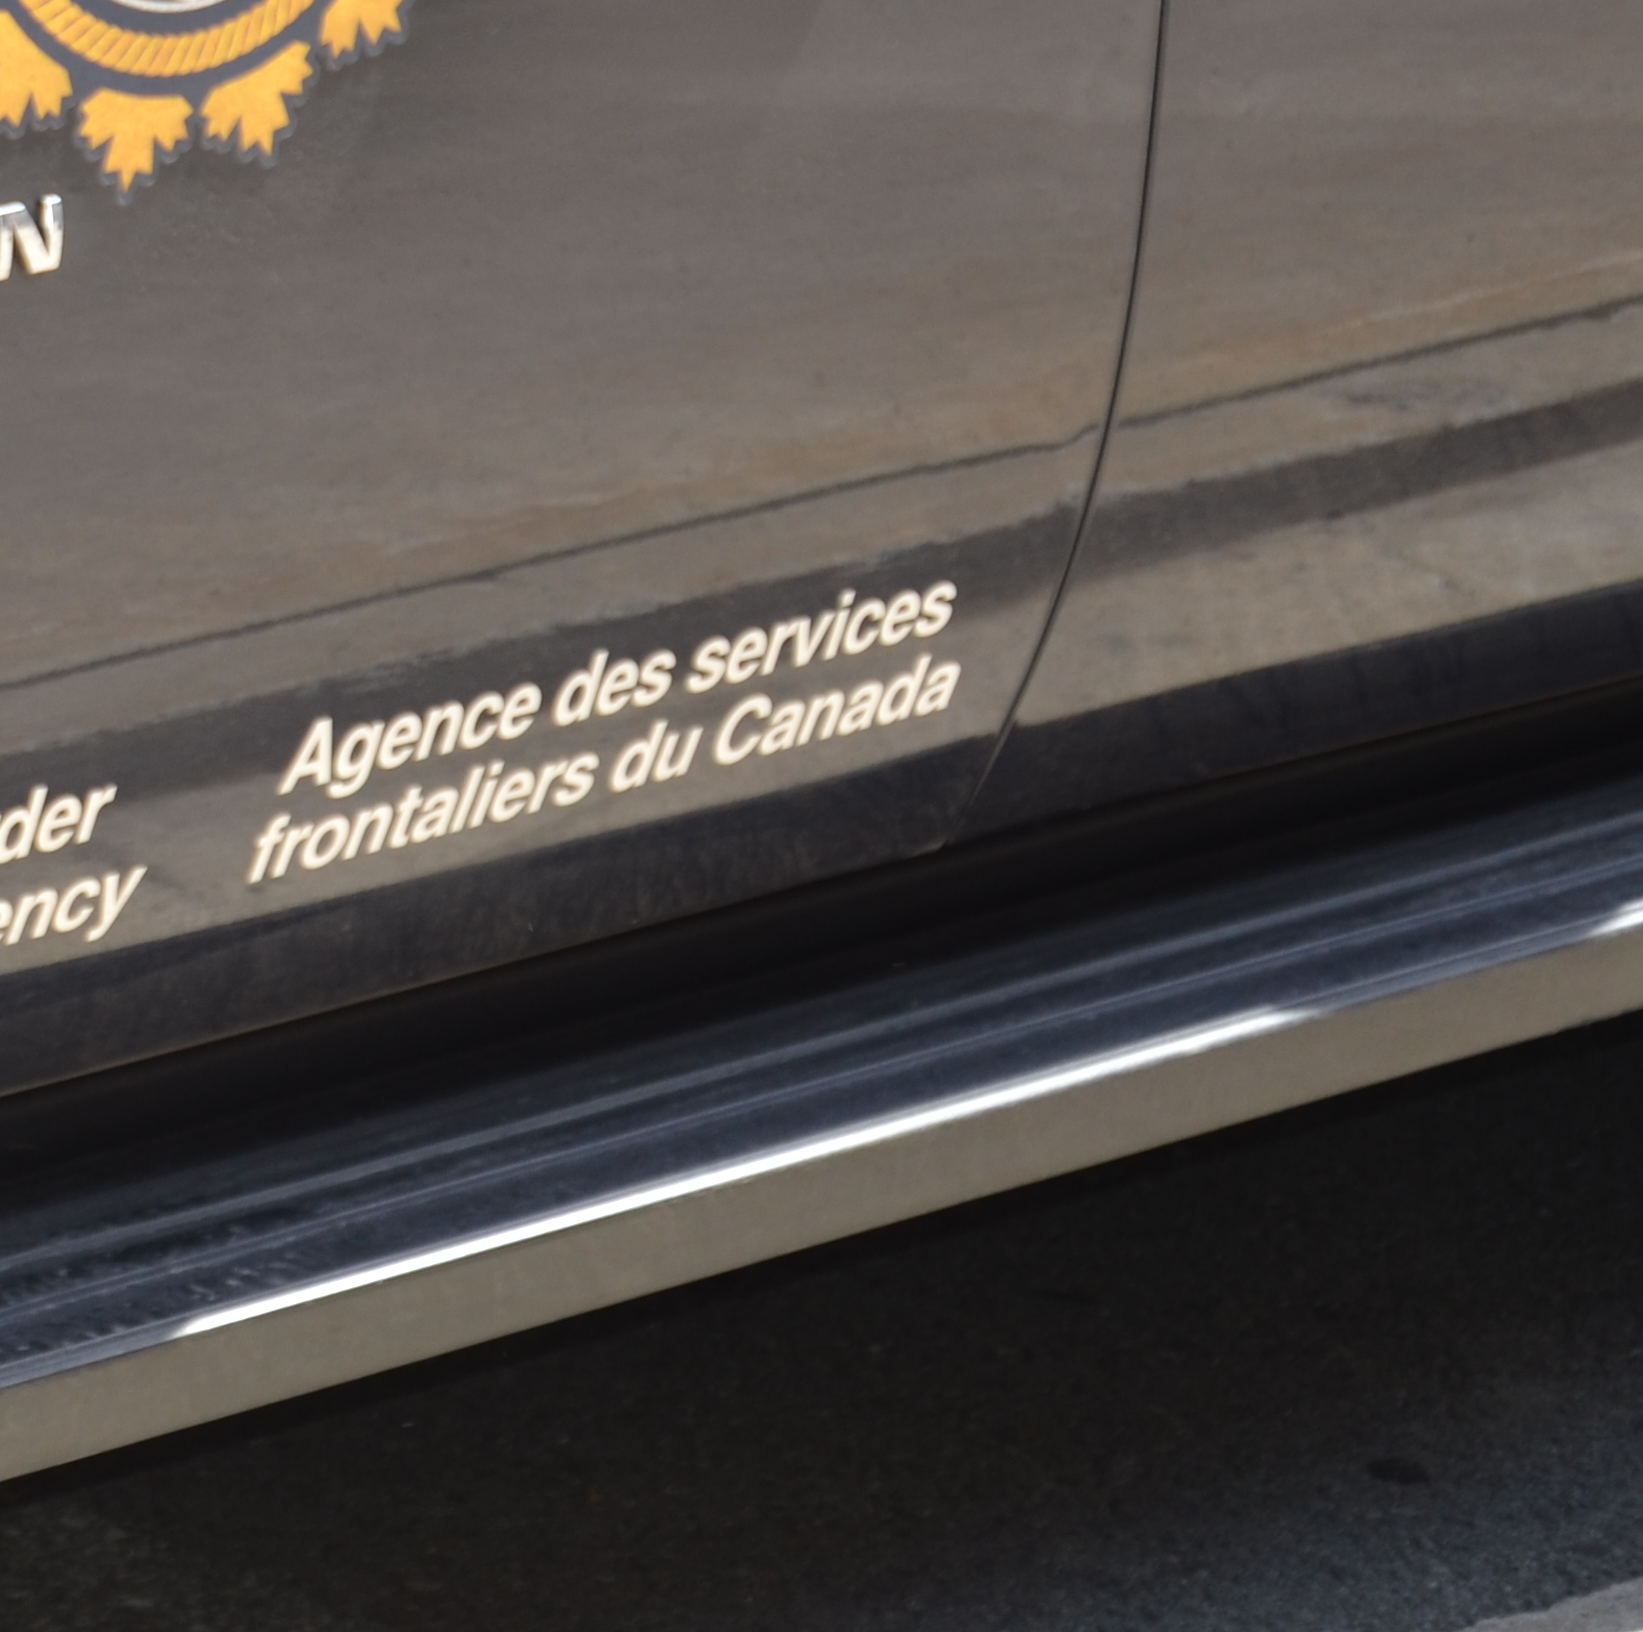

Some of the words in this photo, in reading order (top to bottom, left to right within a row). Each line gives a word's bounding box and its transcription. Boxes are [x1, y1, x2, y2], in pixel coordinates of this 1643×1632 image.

[246, 751, 600, 885] frontaliers
[608, 719, 704, 793] du
[712, 652, 962, 766] Canada
[277, 683, 541, 798] Agence
[552, 650, 675, 728] des
[686, 582, 956, 694] services
